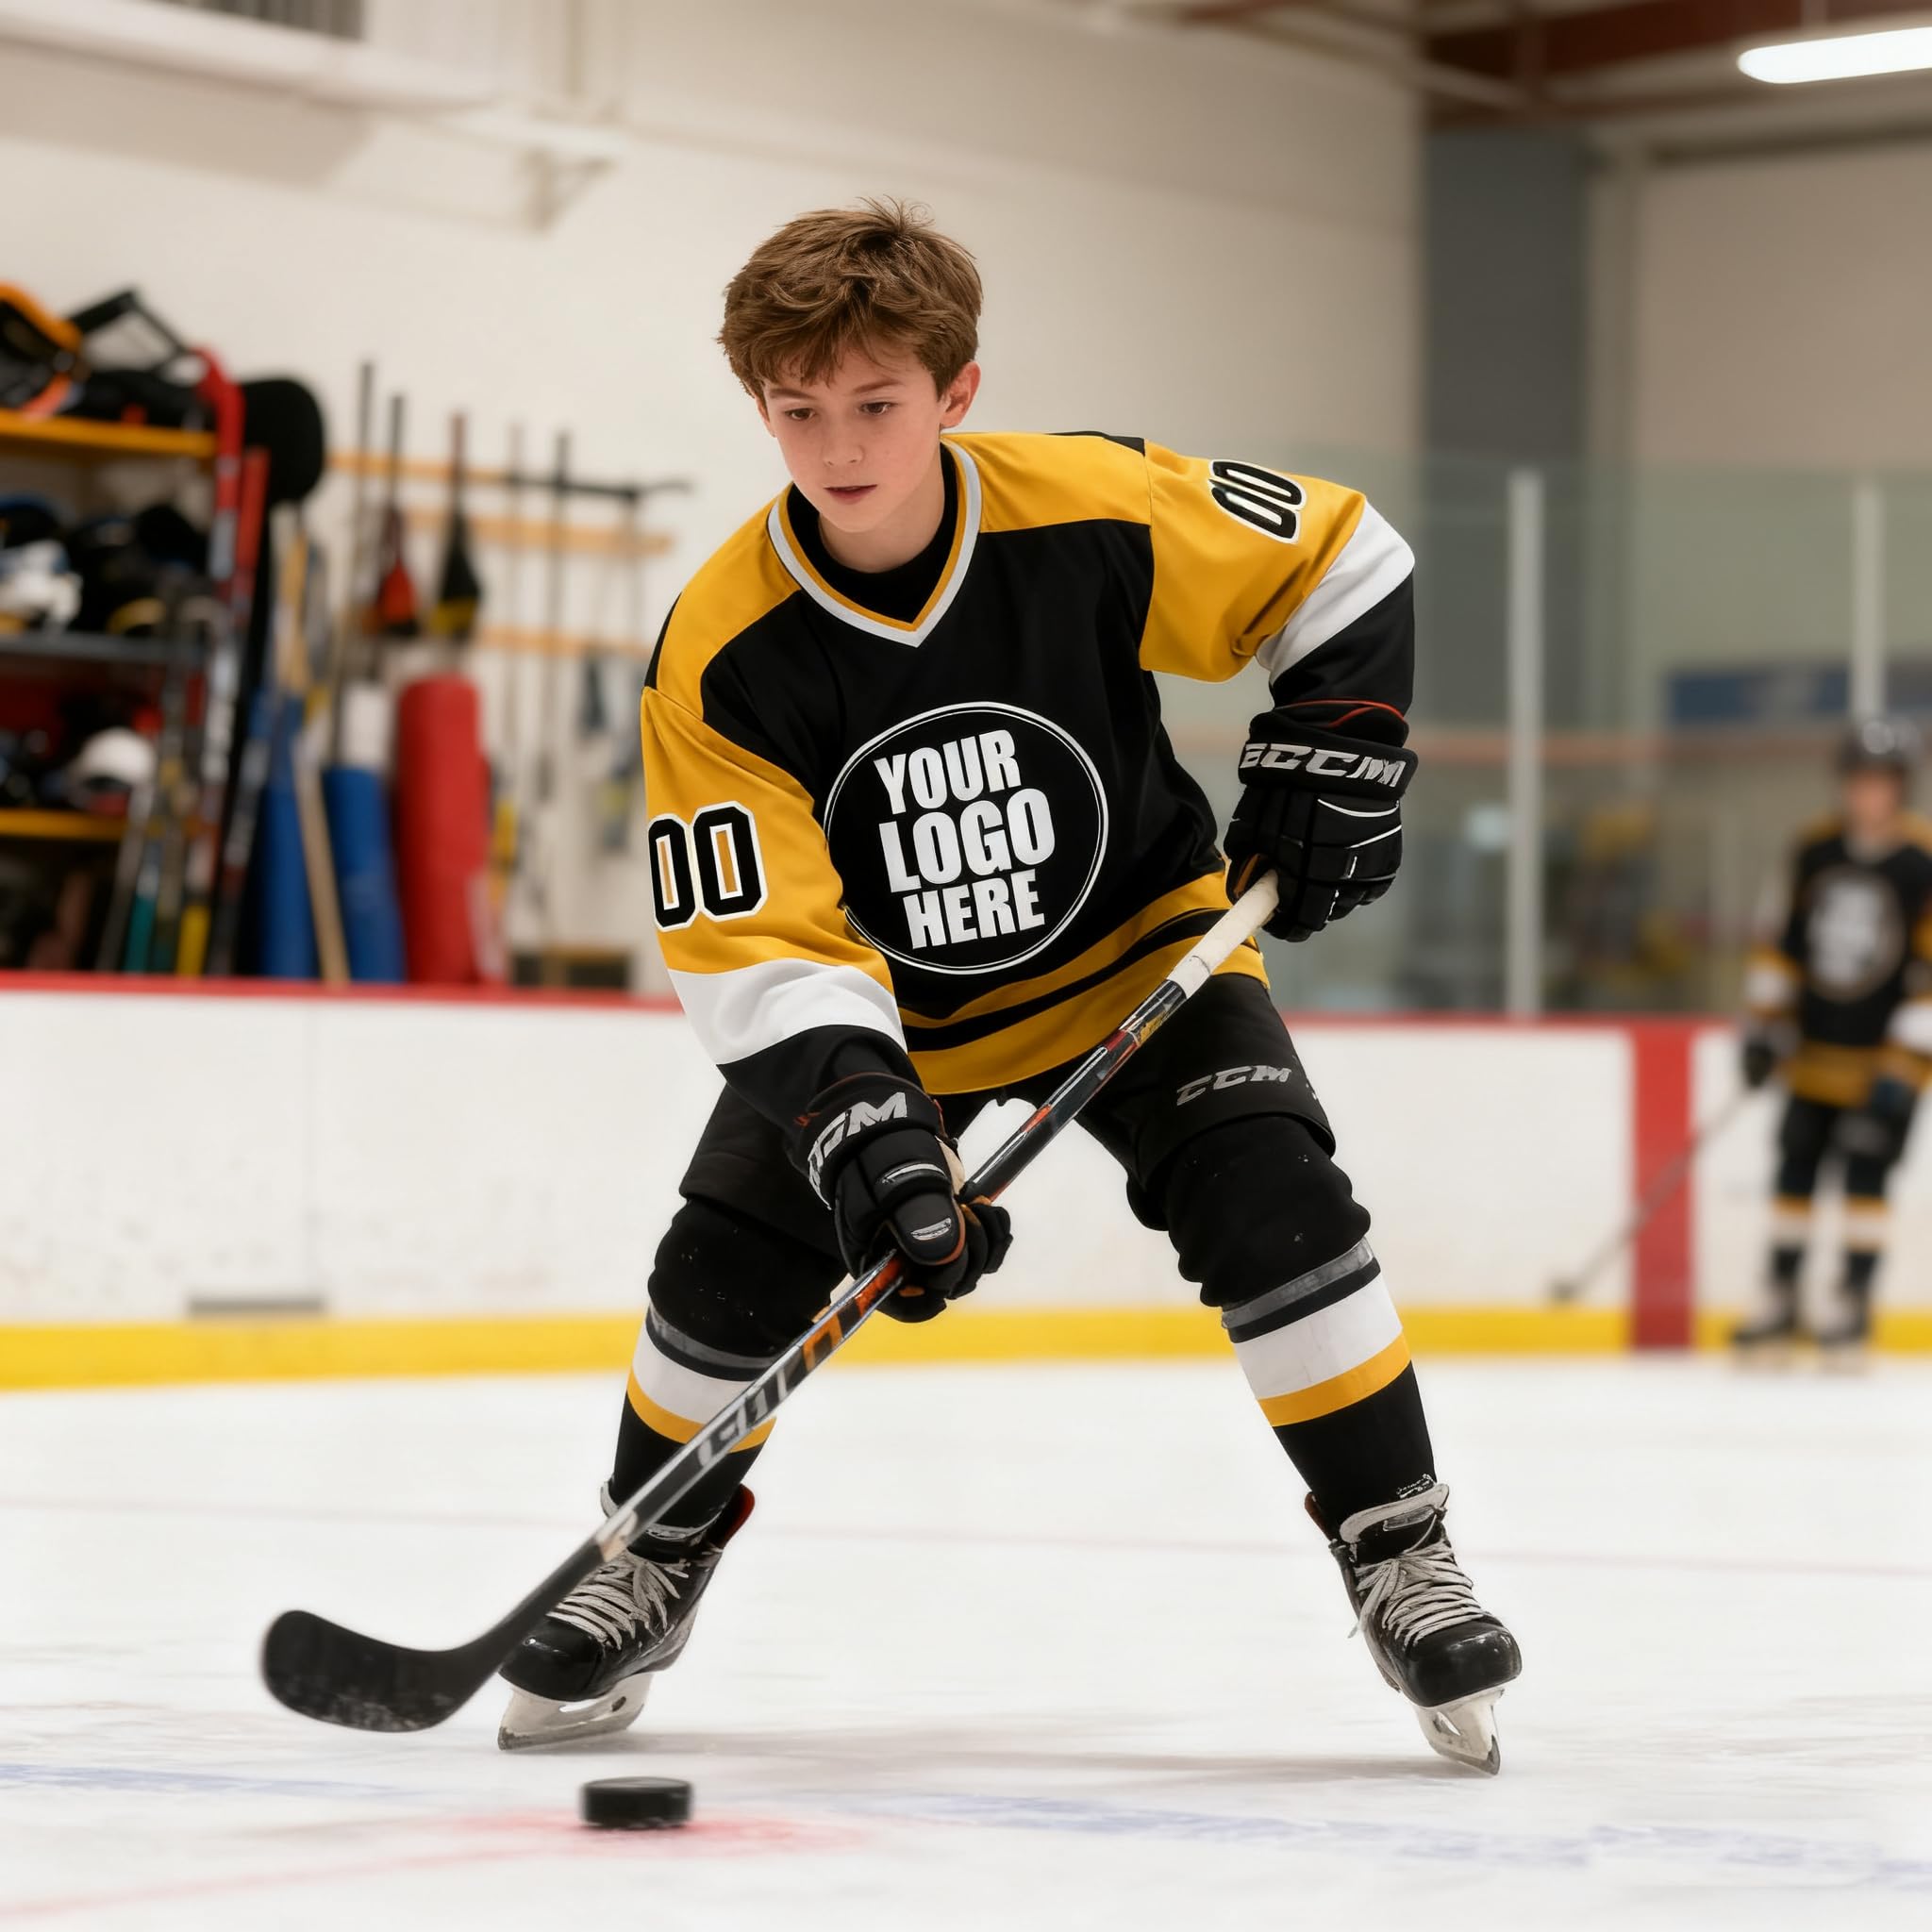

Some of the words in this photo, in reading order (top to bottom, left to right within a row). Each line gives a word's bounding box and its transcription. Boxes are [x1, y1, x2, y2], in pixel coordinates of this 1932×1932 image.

[874, 729, 1022, 815] YOUR
[648, 801, 769, 932] 00
[878, 788, 1056, 893] LOGO
[903, 868, 1045, 949] HERE
[1176, 1065, 1292, 1106] CCM
